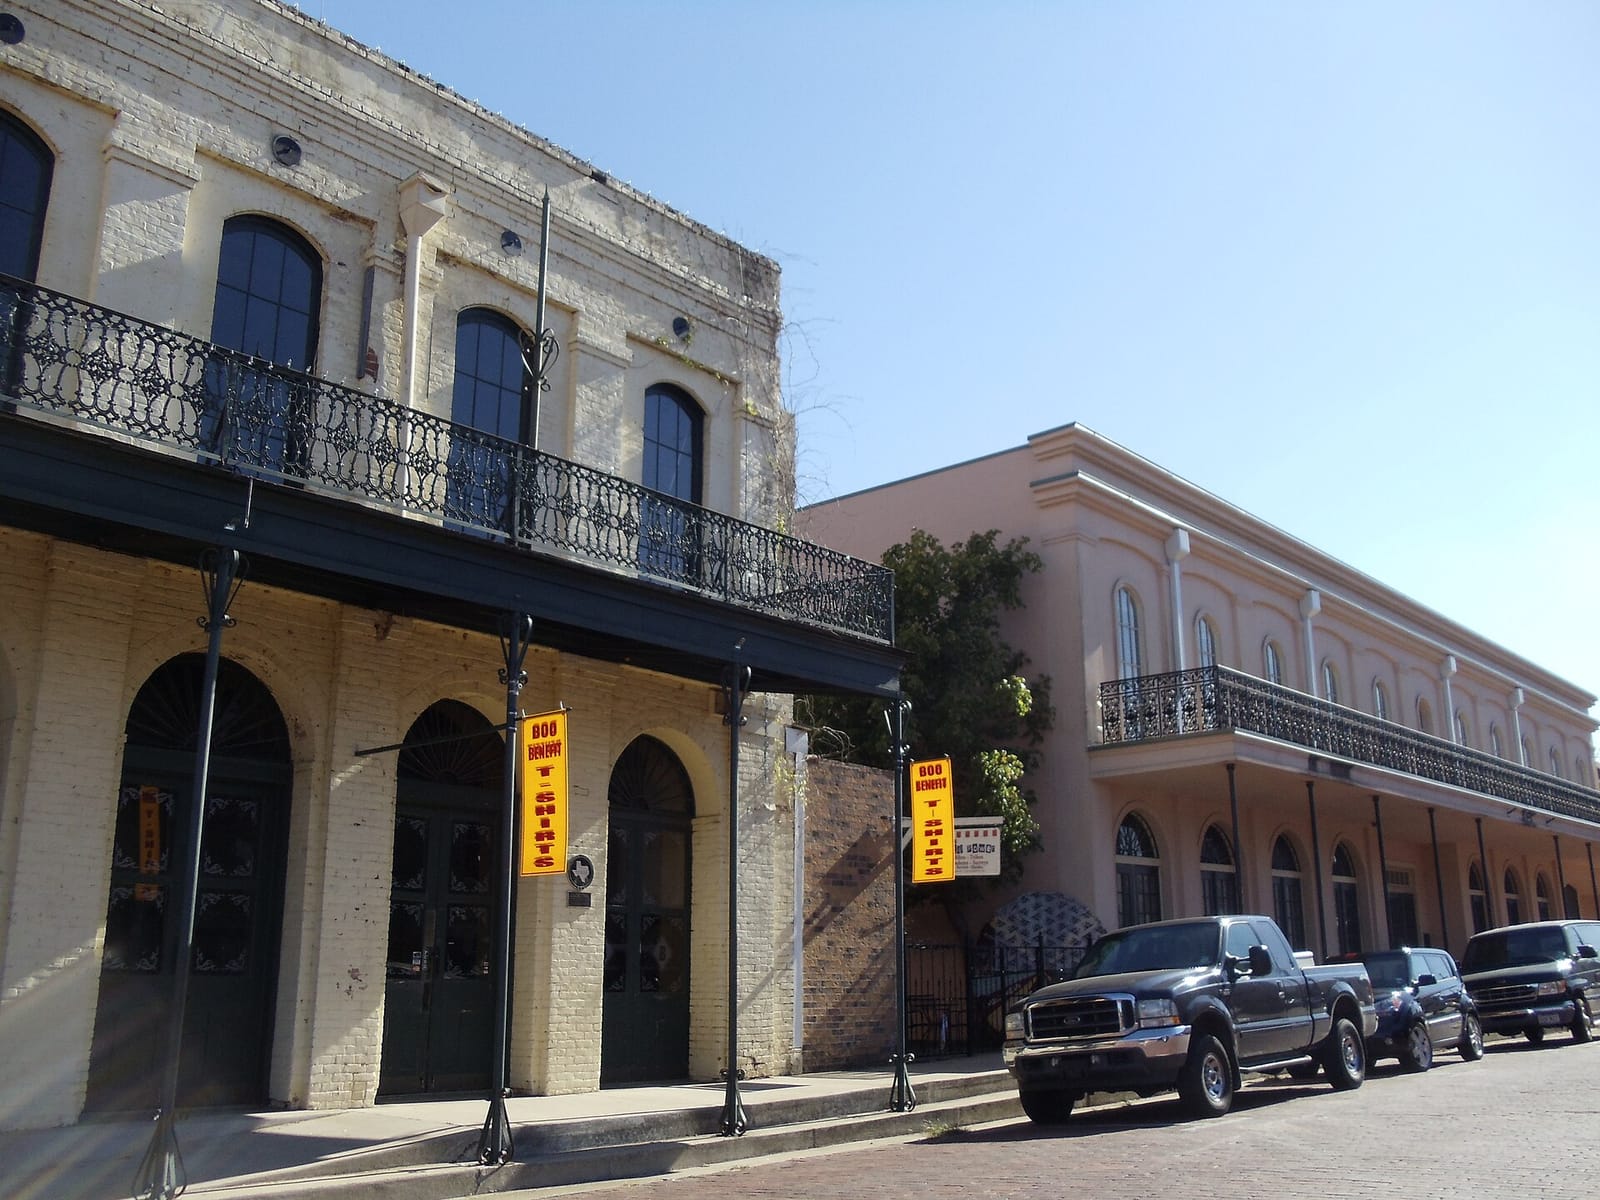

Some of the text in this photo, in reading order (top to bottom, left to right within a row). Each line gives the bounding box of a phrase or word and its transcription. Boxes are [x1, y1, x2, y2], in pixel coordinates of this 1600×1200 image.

[532, 720, 557, 740] BOO
[528, 741, 562, 761] BENEFIT
[919, 764, 942, 777] BOO
[916, 777, 947, 792] BENEFIT
[533, 764, 556, 868] T-SHIRTS
[923, 799, 944, 876] T-SHIRTS
